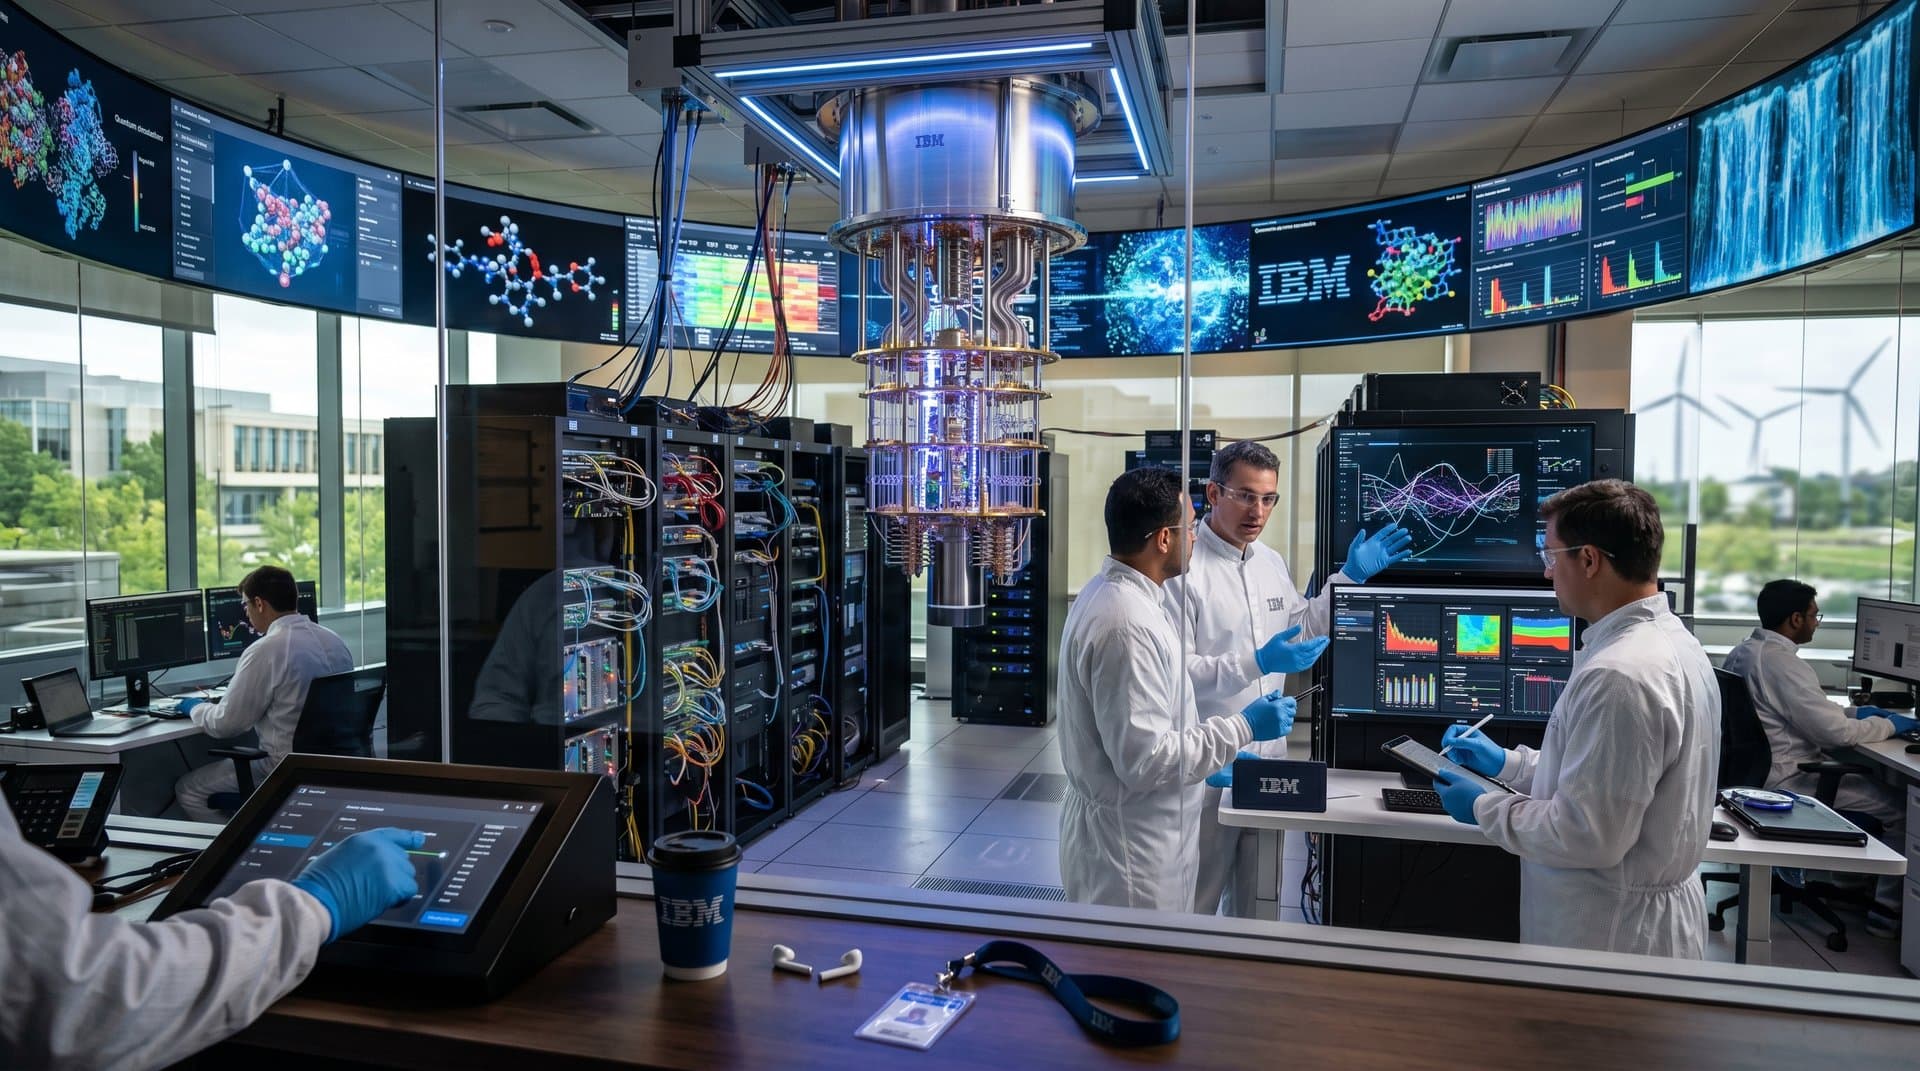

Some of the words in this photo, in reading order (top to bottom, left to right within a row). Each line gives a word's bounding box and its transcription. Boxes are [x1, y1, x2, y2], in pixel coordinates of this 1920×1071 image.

[915, 134, 944, 148] IBM
[1258, 254, 1351, 305] IBM
[1267, 597, 1284, 612] IBM
[1259, 777, 1299, 795] IBM
[660, 894, 725, 927] IBM
[1041, 963, 1063, 989] IBM
[1091, 1009, 1115, 1034] IBM
